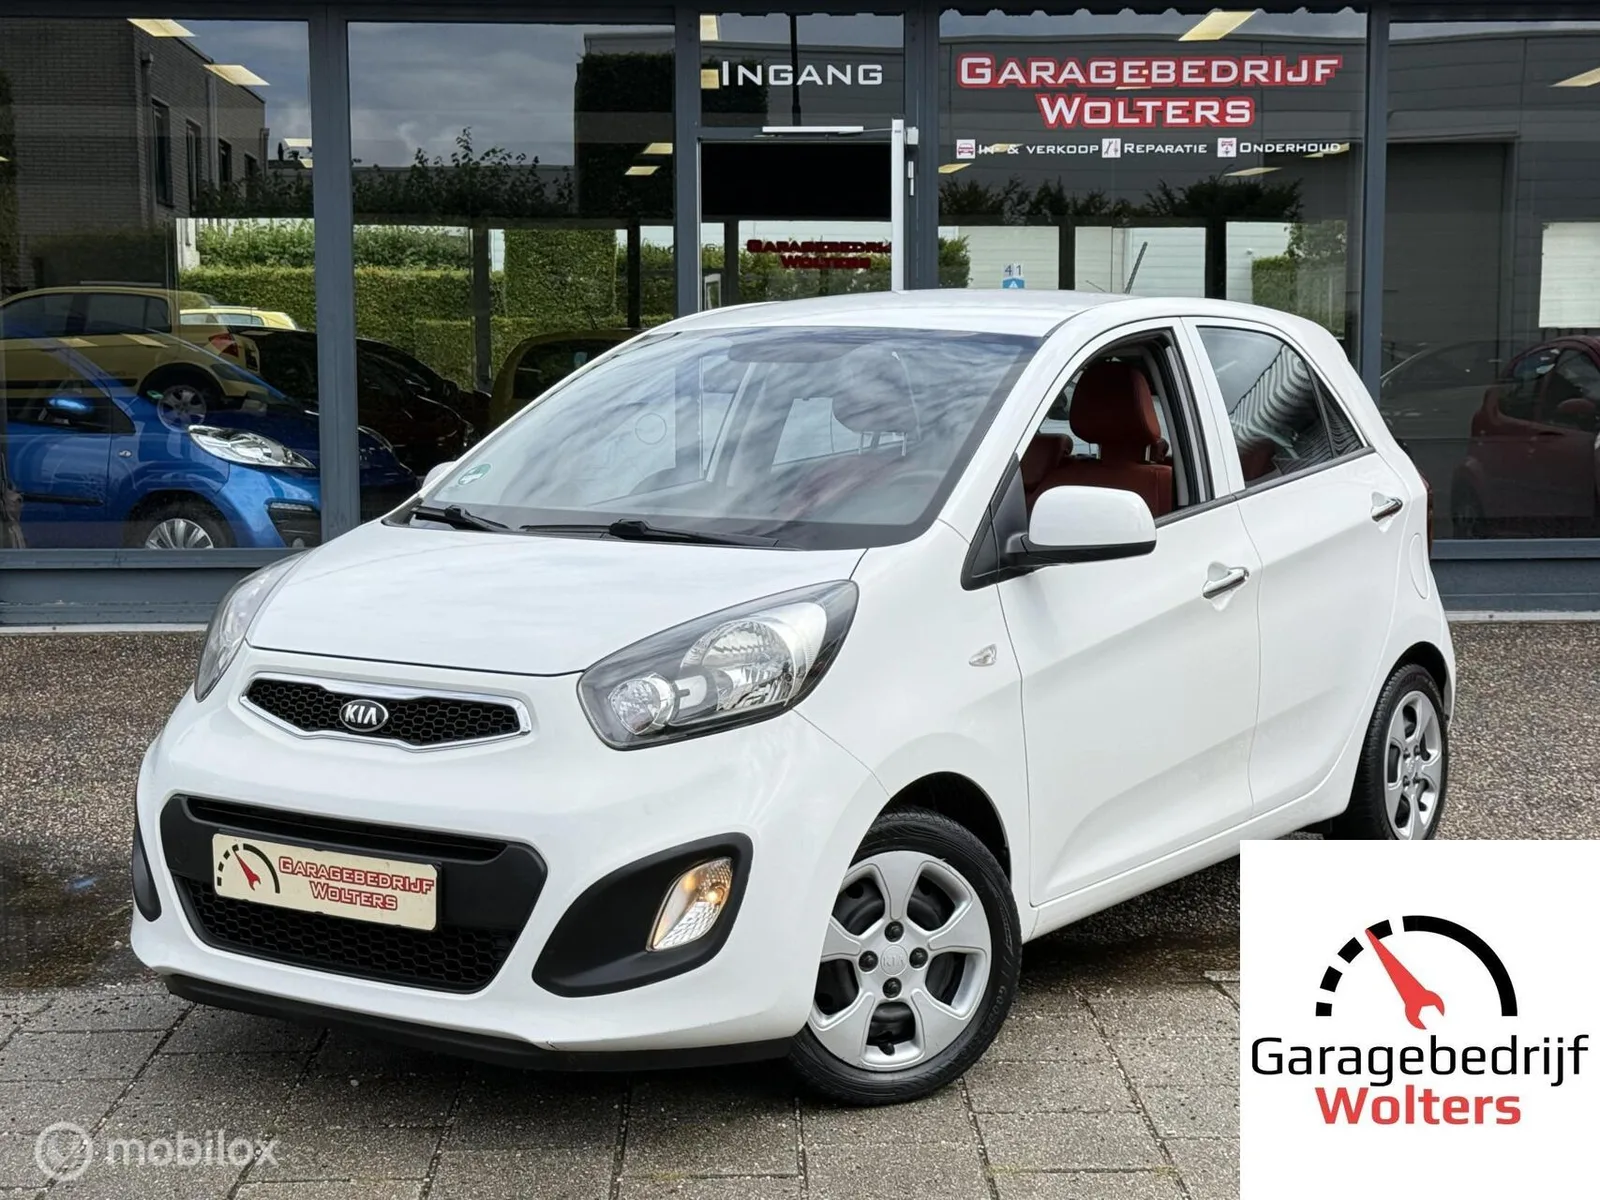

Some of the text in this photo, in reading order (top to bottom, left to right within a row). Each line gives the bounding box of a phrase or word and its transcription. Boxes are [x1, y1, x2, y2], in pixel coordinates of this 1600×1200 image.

[722, 61, 883, 86] INGANG
[958, 55, 1341, 88] GARAGEBEDRIJF
[1038, 96, 1254, 127] WOLTERS
[1026, 144, 1099, 154] VERKOOP
[1124, 143, 1207, 154] REPARATIE
[1240, 142, 1341, 153] ONDERHOUD
[1004, 264, 1022, 276] 41
[345, 704, 378, 725] KIA
[279, 856, 434, 894] GARAGEBEDRIJF
[309, 880, 397, 910] WOLTERS
